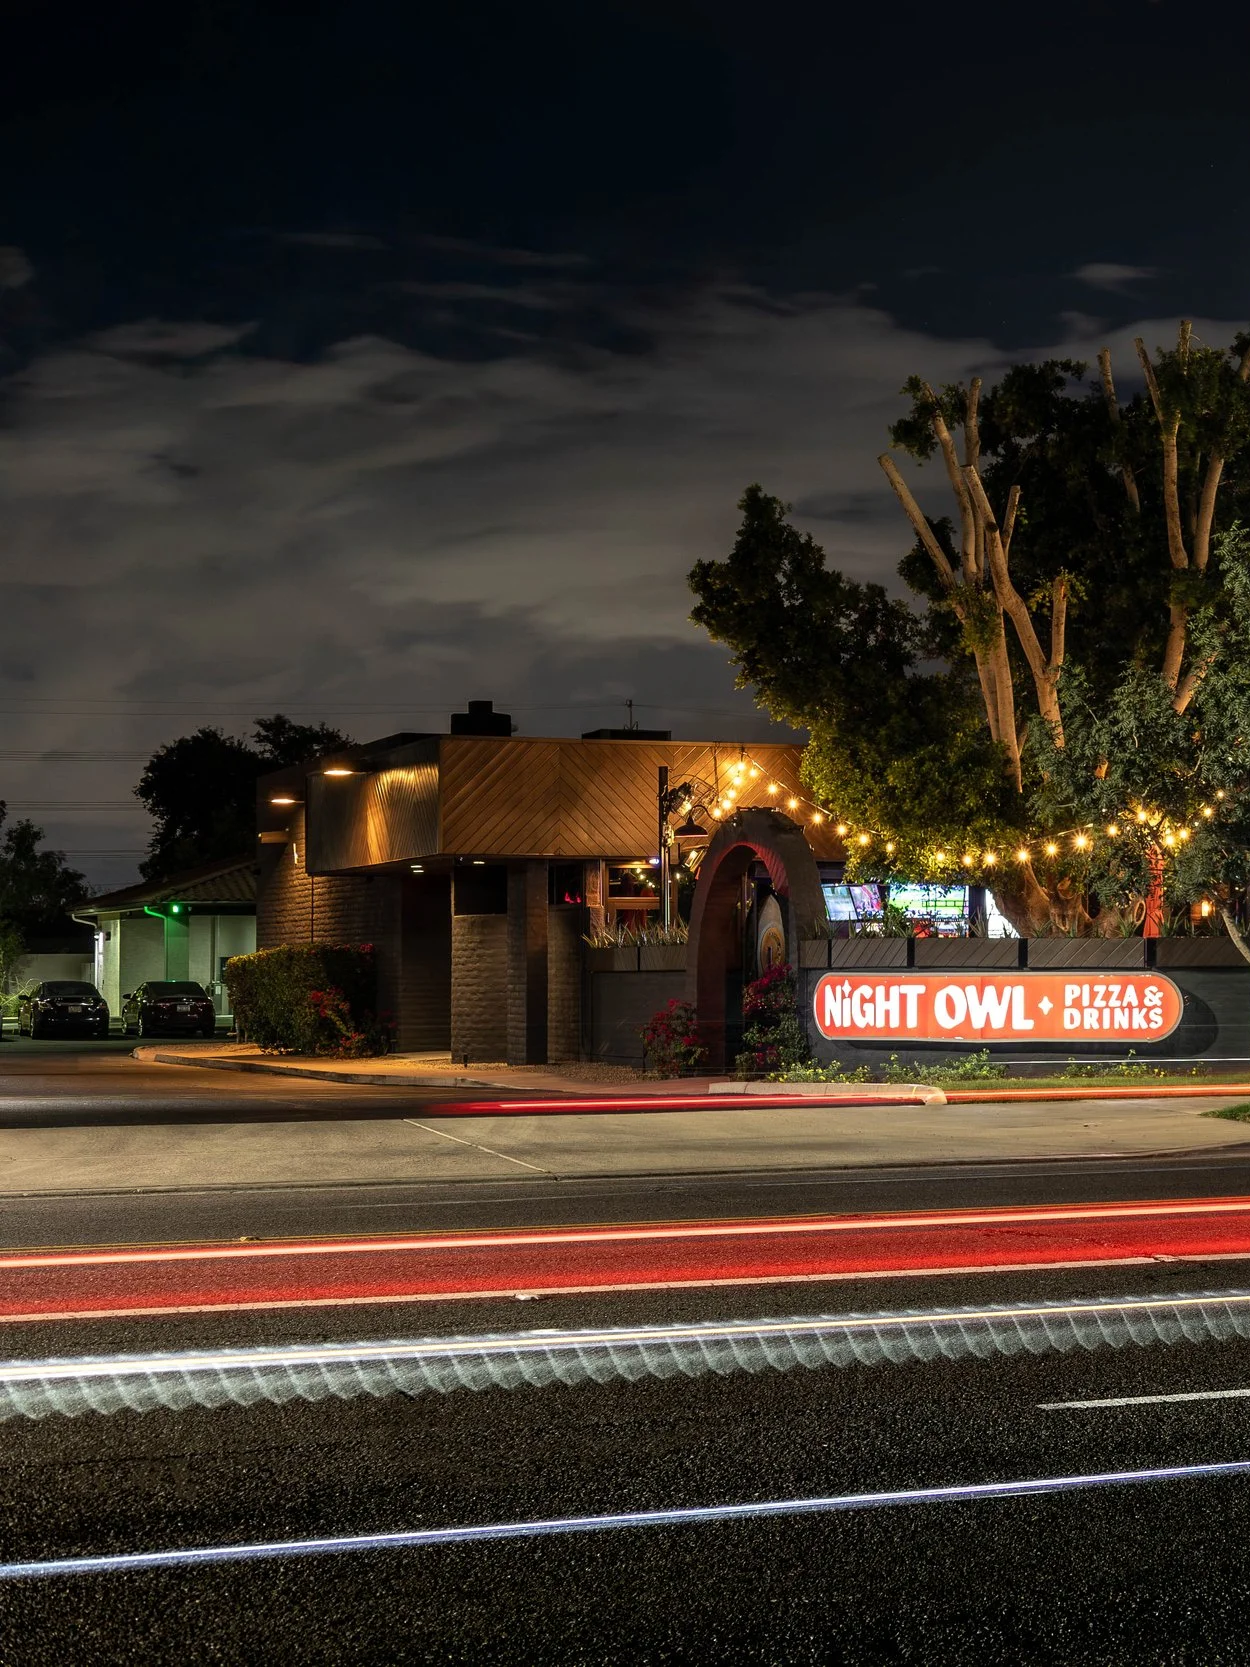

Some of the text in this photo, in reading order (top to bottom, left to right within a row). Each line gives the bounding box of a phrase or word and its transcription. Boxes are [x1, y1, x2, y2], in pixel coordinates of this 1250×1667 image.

[934, 984, 1035, 1030] OWL
[1064, 984, 1164, 1007] PIZZA &
[1063, 1007, 1164, 1030] DRINKS
